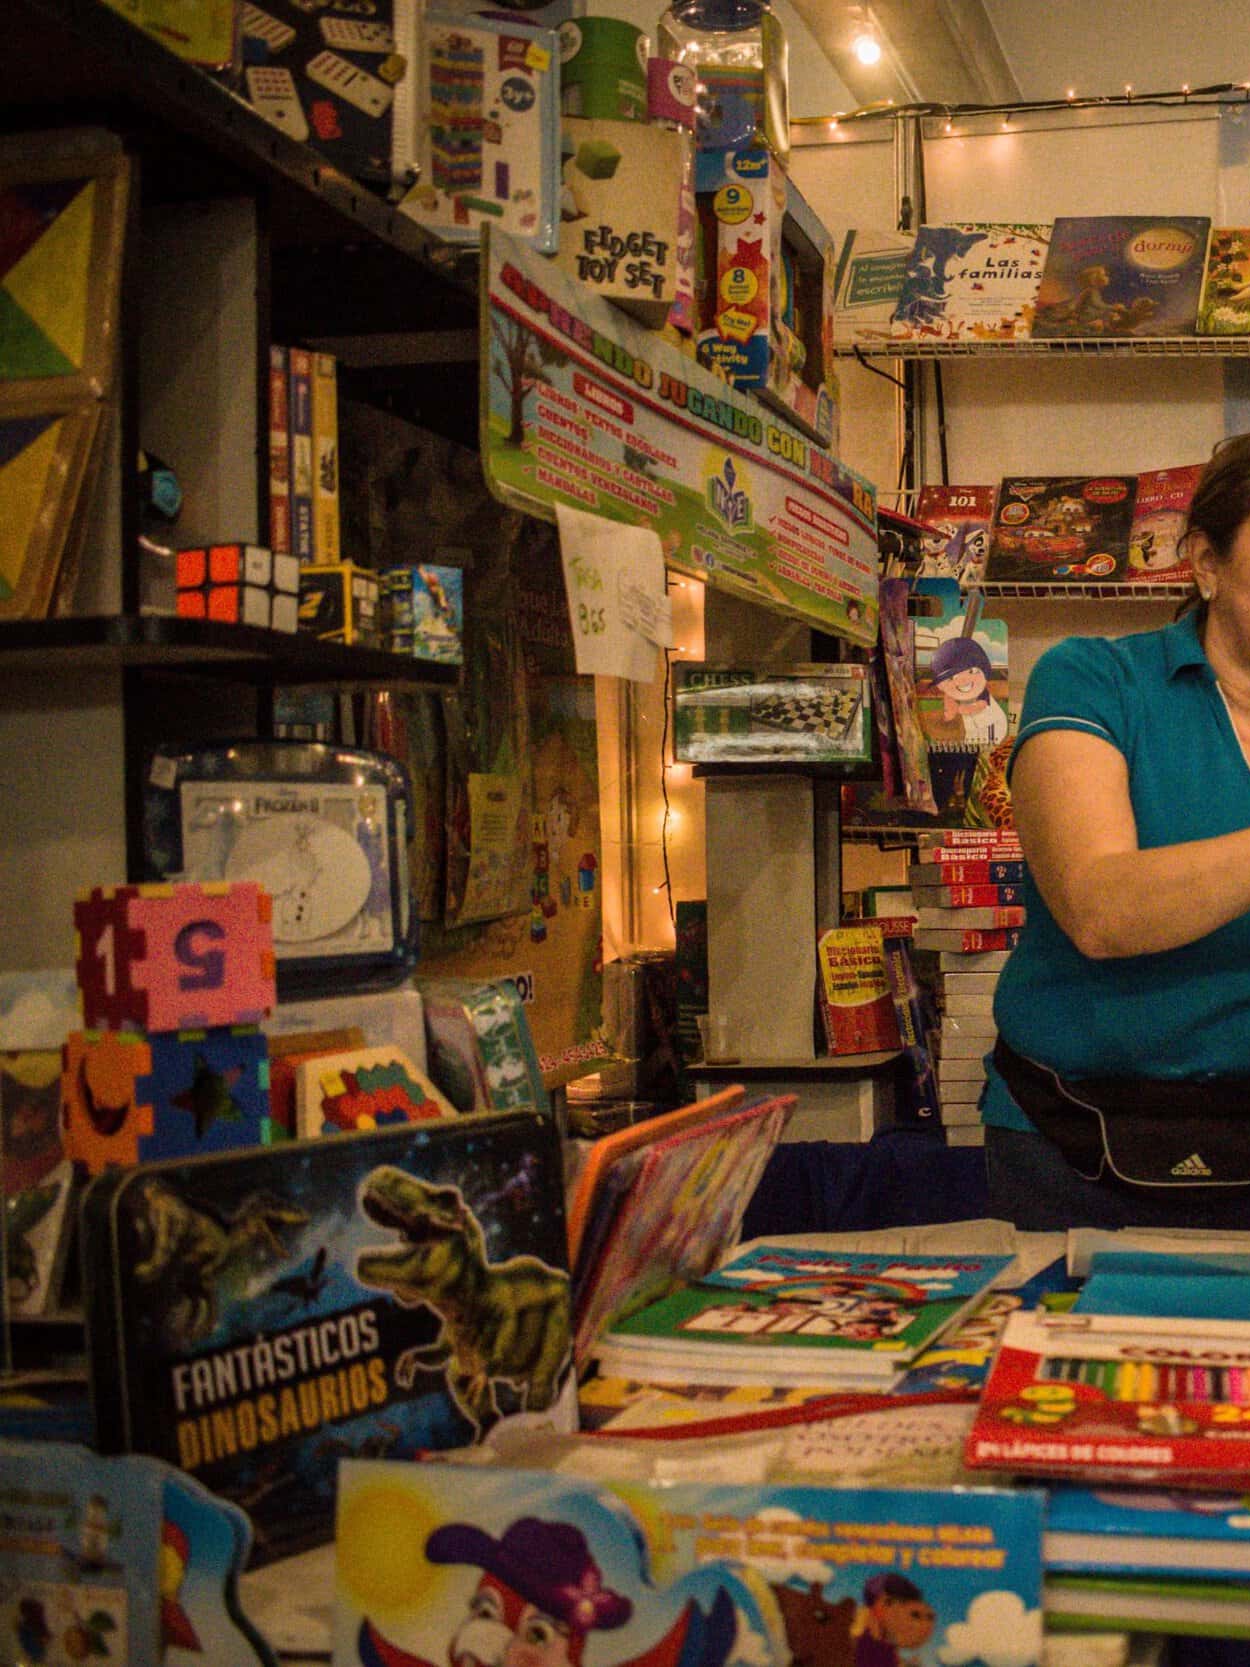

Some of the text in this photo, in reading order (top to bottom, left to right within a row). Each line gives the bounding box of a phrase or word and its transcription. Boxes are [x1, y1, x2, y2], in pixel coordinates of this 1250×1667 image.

[727, 188, 740, 204] 9
[583, 225, 669, 266] FIDGET
[575, 254, 620, 283] TOY
[958, 268, 1044, 279] familias
[985, 257, 1020, 268] Las
[623, 260, 667, 299] SET
[732, 268, 745, 284] 8
[658, 371, 763, 446] JUGANDO
[766, 423, 807, 471] CON
[948, 495, 977, 507] 101
[689, 673, 750, 687] CHESS
[96, 918, 226, 996] 1 5
[1171, 1166, 1213, 1177] adidas
[172, 1309, 380, 1412] FANTÁSTICOS
[177, 1358, 388, 1471] DINOSAURIOS
